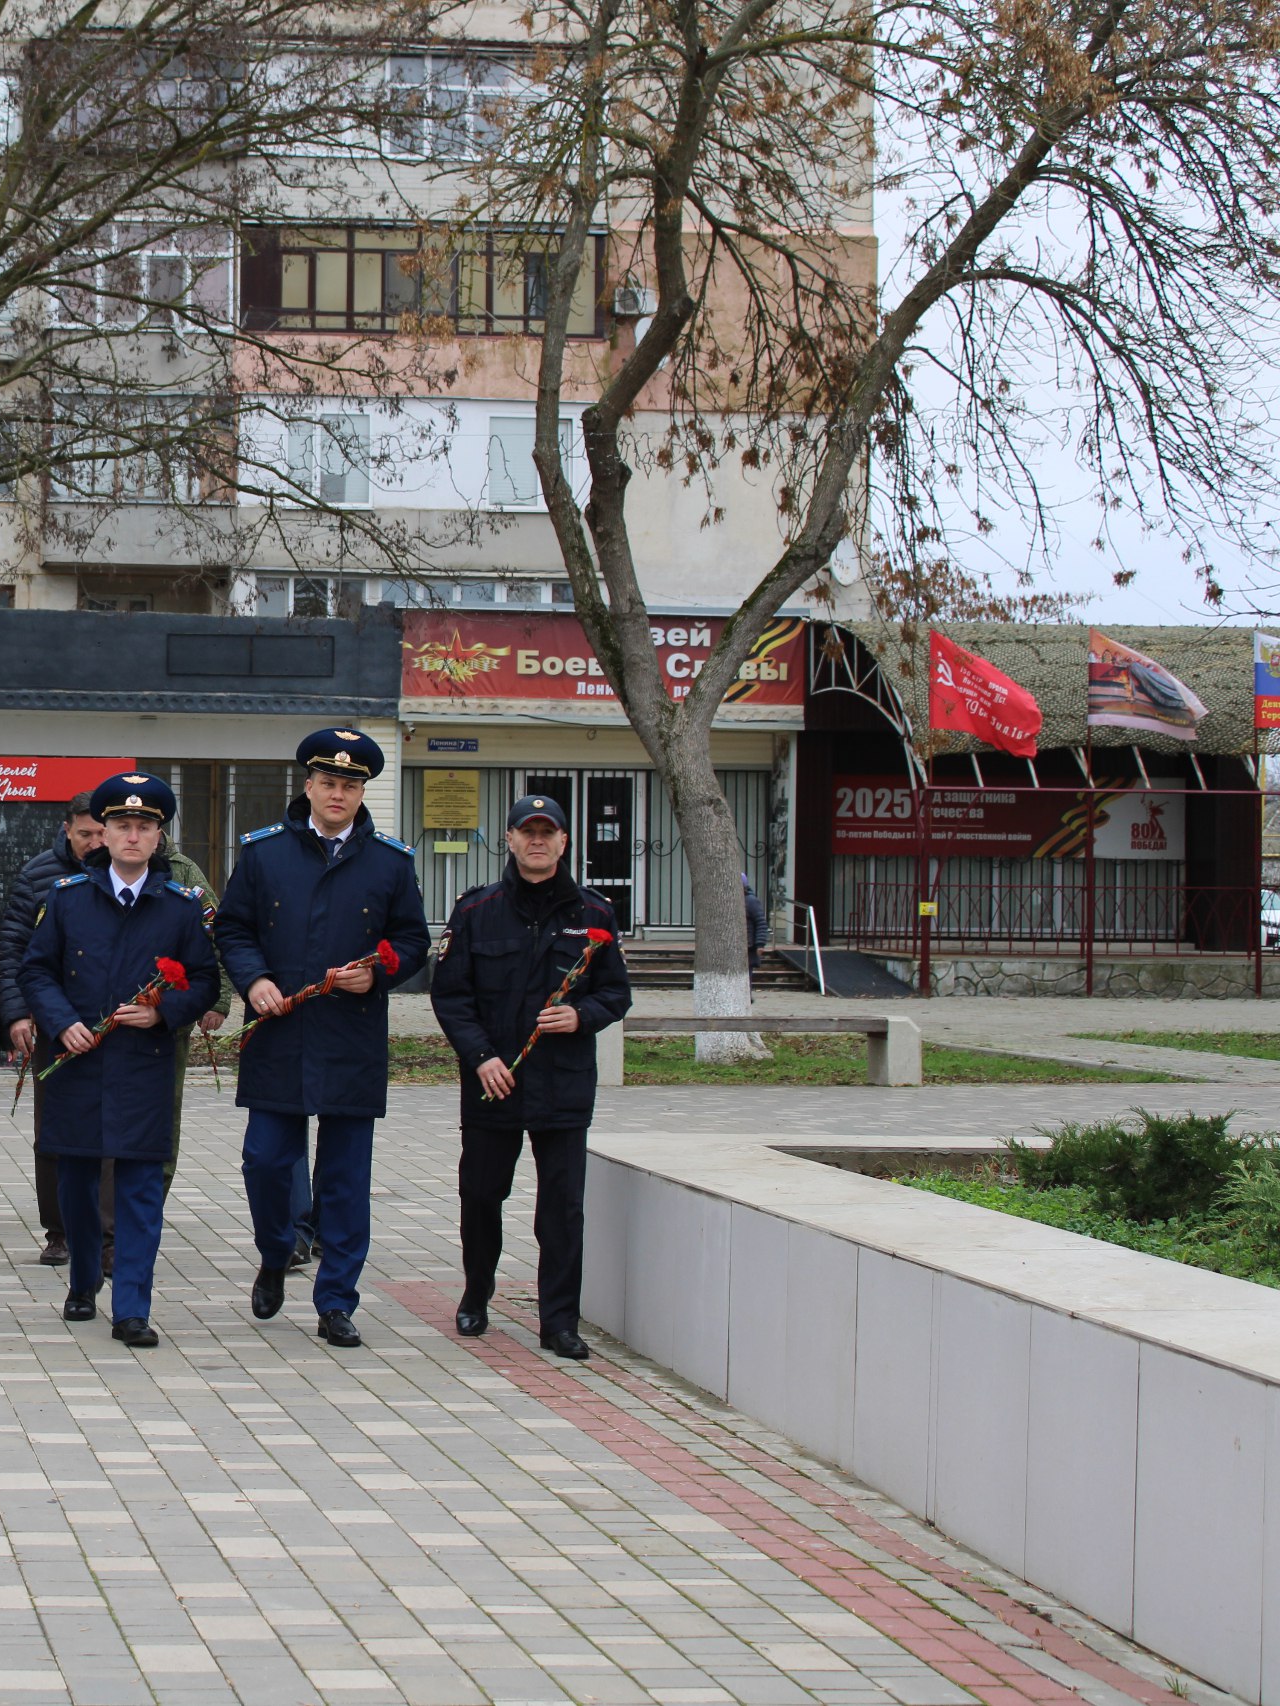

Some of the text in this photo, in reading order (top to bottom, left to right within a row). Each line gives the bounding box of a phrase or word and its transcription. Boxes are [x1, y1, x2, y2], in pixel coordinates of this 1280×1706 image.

[650, 621, 711, 647] зей
[517, 650, 605, 676] Боев
[460, 741, 465, 750] 7
[836, 787, 912, 818] 2025
[873, 830, 905, 840] Победы
[1131, 822, 1150, 839] 80
[1131, 840, 1167, 851] ПОБЕДА!
